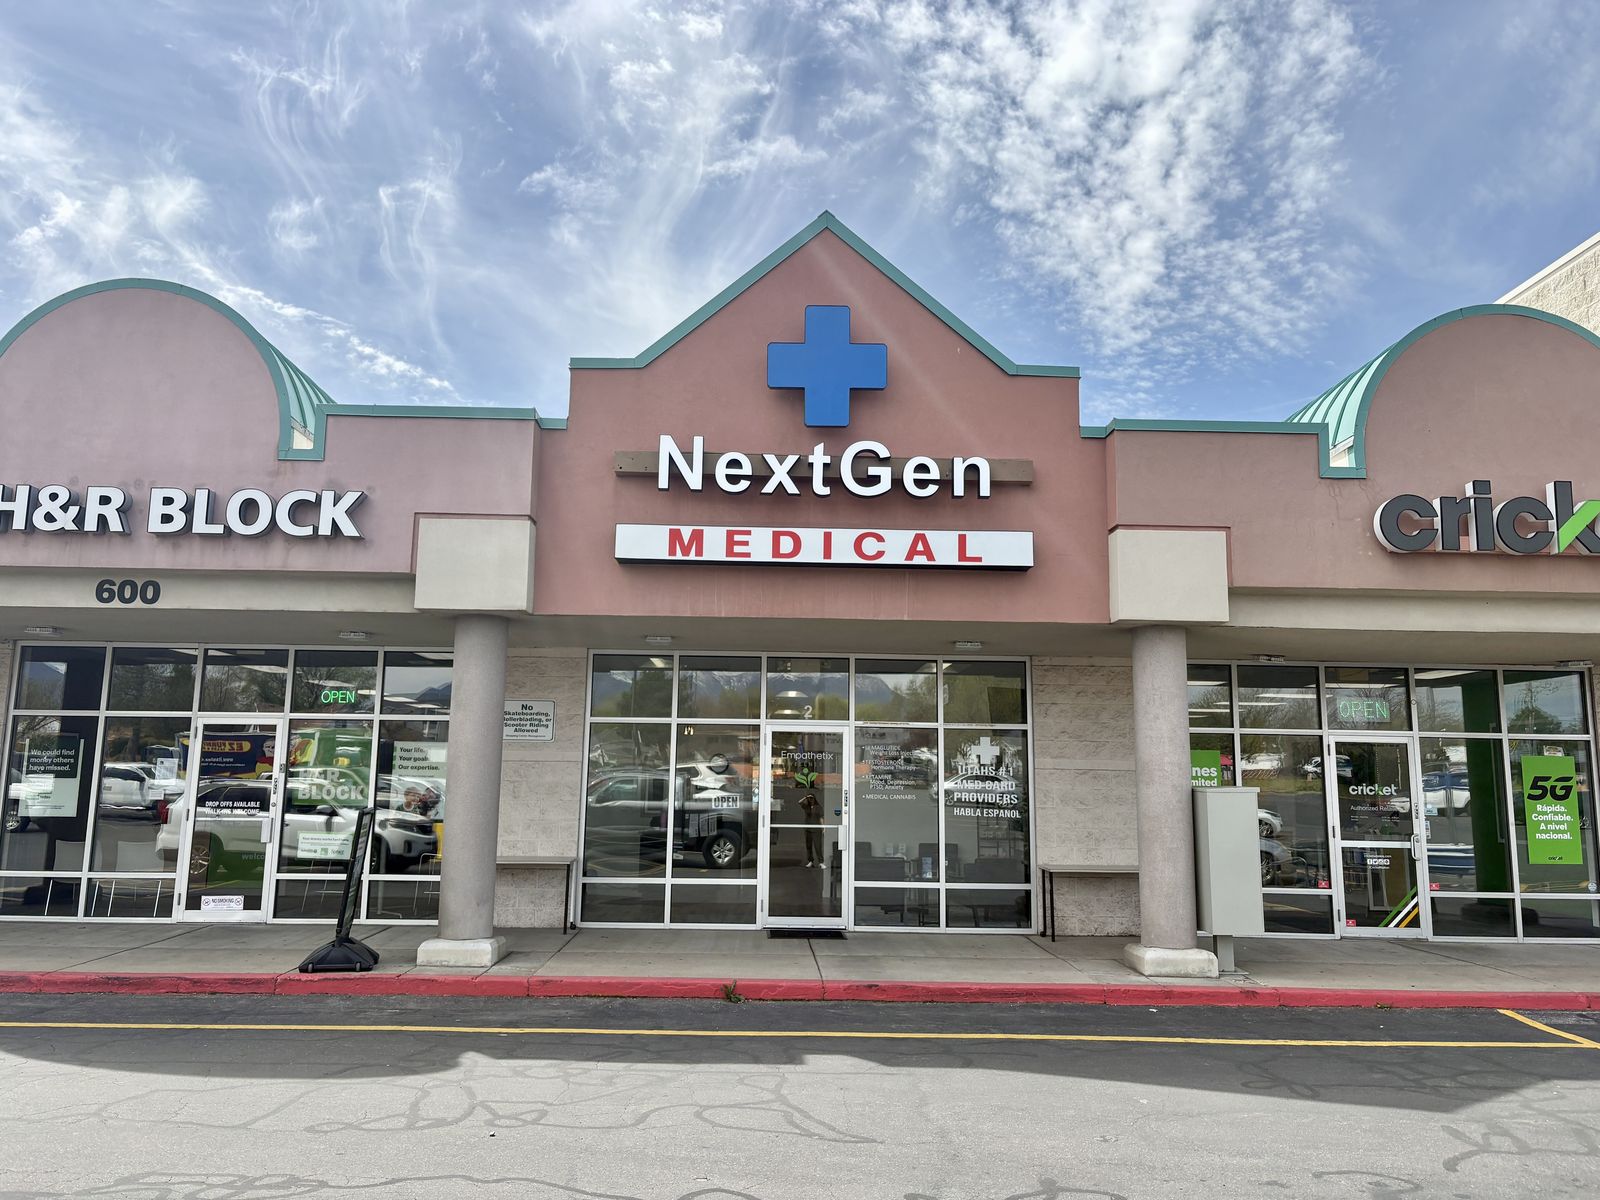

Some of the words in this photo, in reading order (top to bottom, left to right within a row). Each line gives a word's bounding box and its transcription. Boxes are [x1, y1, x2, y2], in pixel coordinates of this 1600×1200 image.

[657, 434, 991, 498] NextGen
[0, 484, 131, 534] H&R
[147, 486, 365, 540] BLOCK
[668, 528, 983, 562] MEDICAL
[95, 578, 161, 605] 600
[320, 690, 355, 704] OPEN
[521, 703, 533, 711] No
[803, 704, 813, 718] 2
[1339, 701, 1387, 719] OPEN
[780, 750, 834, 760] Empathetix
[28, 764, 45, 772] have
[958, 765, 996, 776] UTAHS
[997, 766, 1014, 777] #1
[957, 780, 982, 790] MED
[985, 780, 1016, 791] CARD
[1348, 783, 1397, 796] cricket
[1526, 776, 1574, 801] 5G
[297, 785, 364, 800] BLOCK
[953, 792, 1018, 804] PROVIDERS
[713, 796, 738, 808] OPEN
[953, 807, 982, 817] HABLA
[983, 808, 1022, 818] ESPANOL
[1536, 804, 1567, 814] Rápida.
[1532, 813, 1574, 821] Confiable.
[1547, 822, 1567, 831] nivel
[1535, 831, 1573, 840] nacional.
